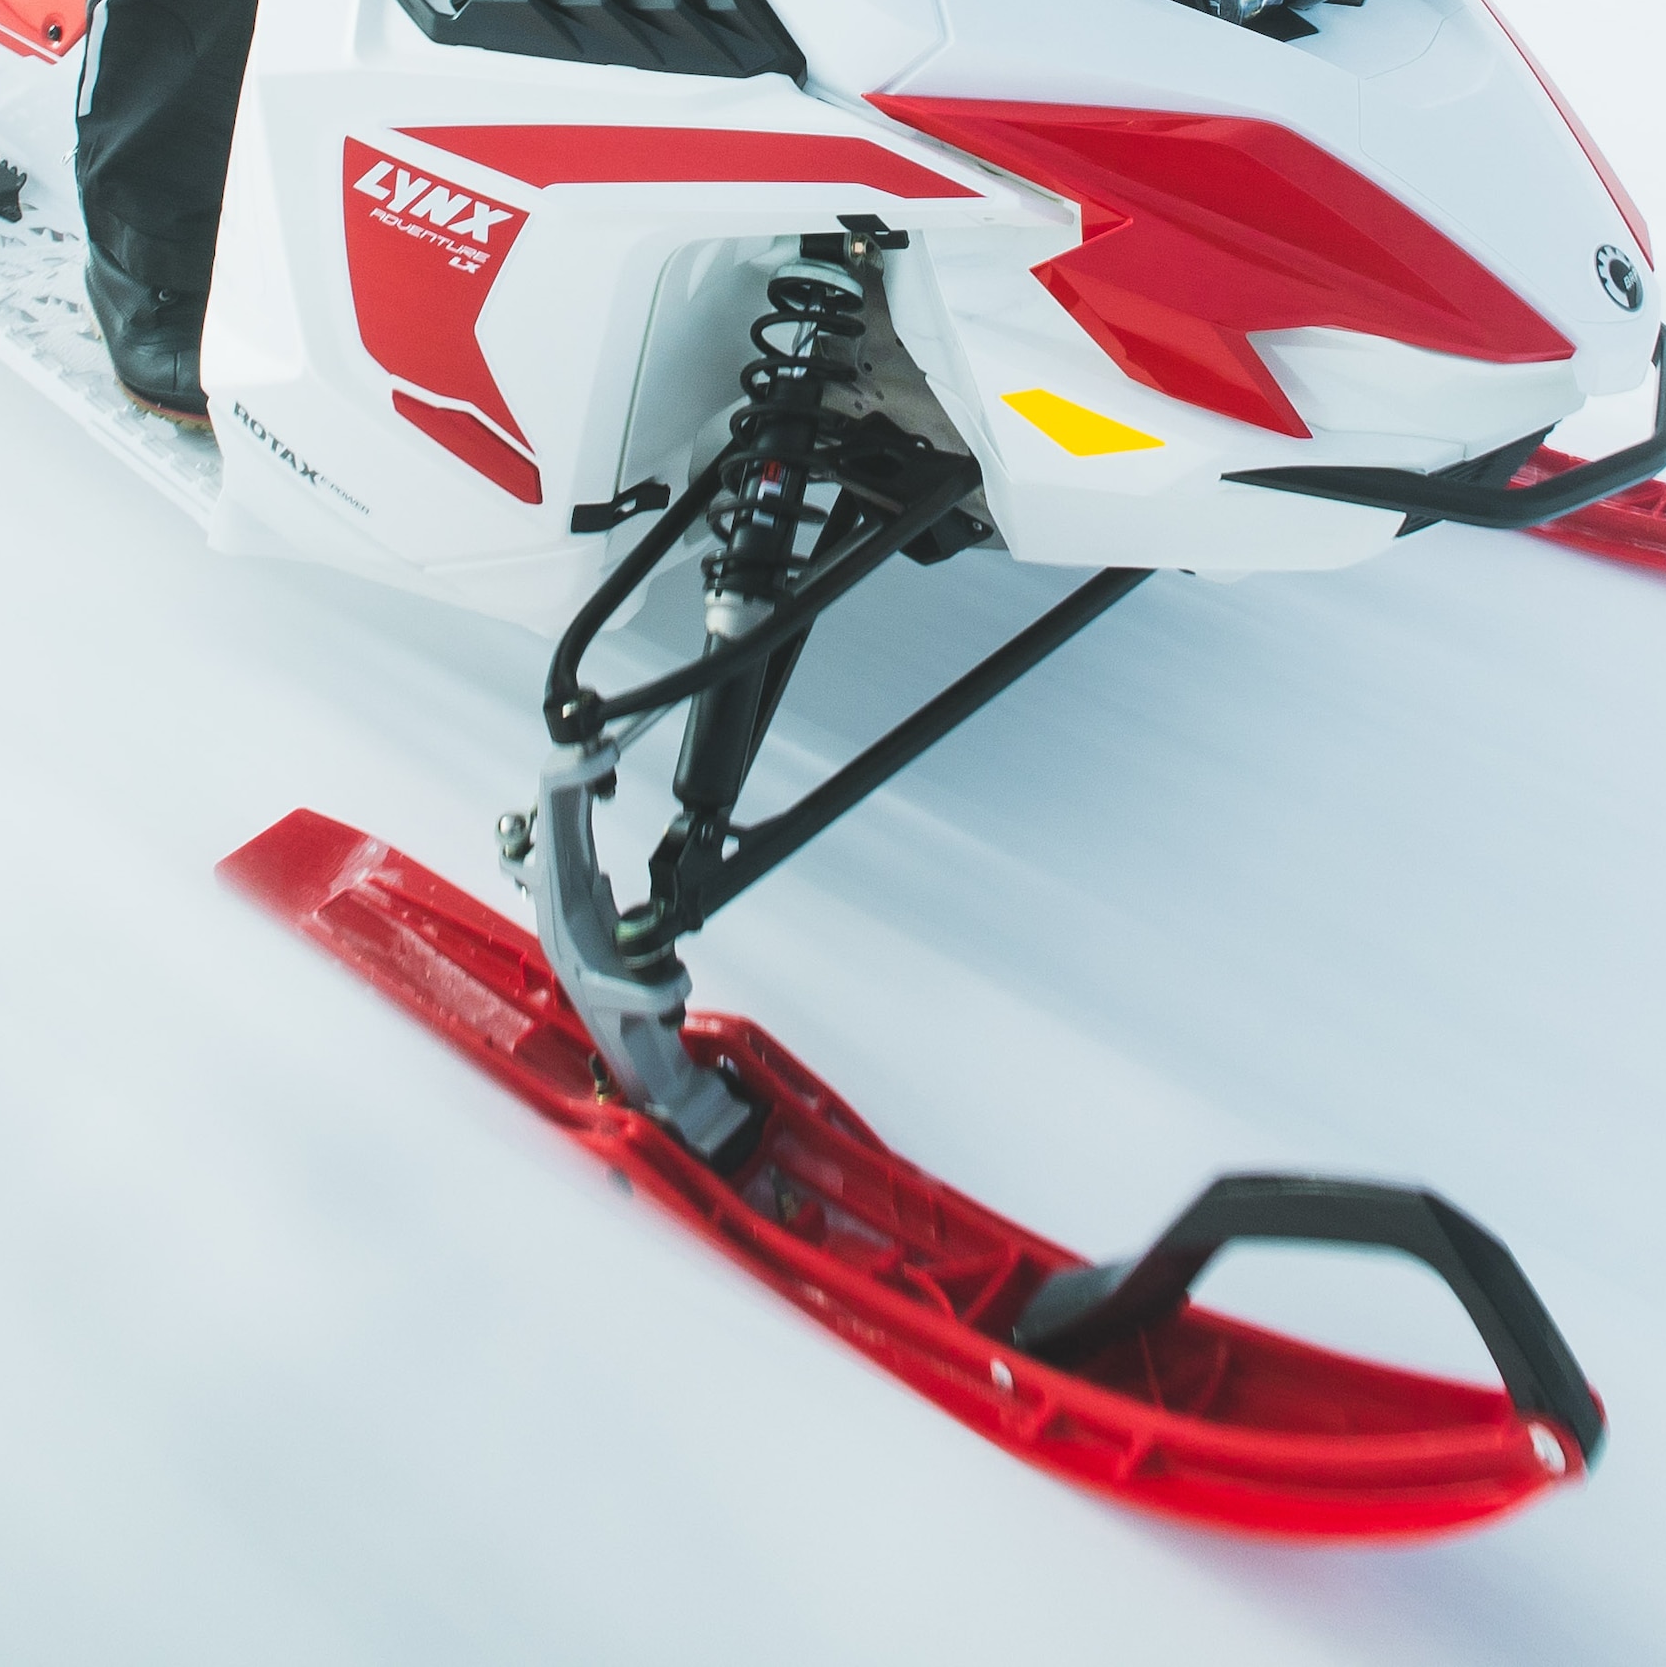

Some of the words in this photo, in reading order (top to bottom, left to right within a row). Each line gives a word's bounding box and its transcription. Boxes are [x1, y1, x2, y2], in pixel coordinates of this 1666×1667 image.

[353, 160, 514, 245] LYNX
[369, 207, 491, 263] ADVENTURE
[448, 256, 482, 274] LX
[233, 401, 319, 486] ROTAX
